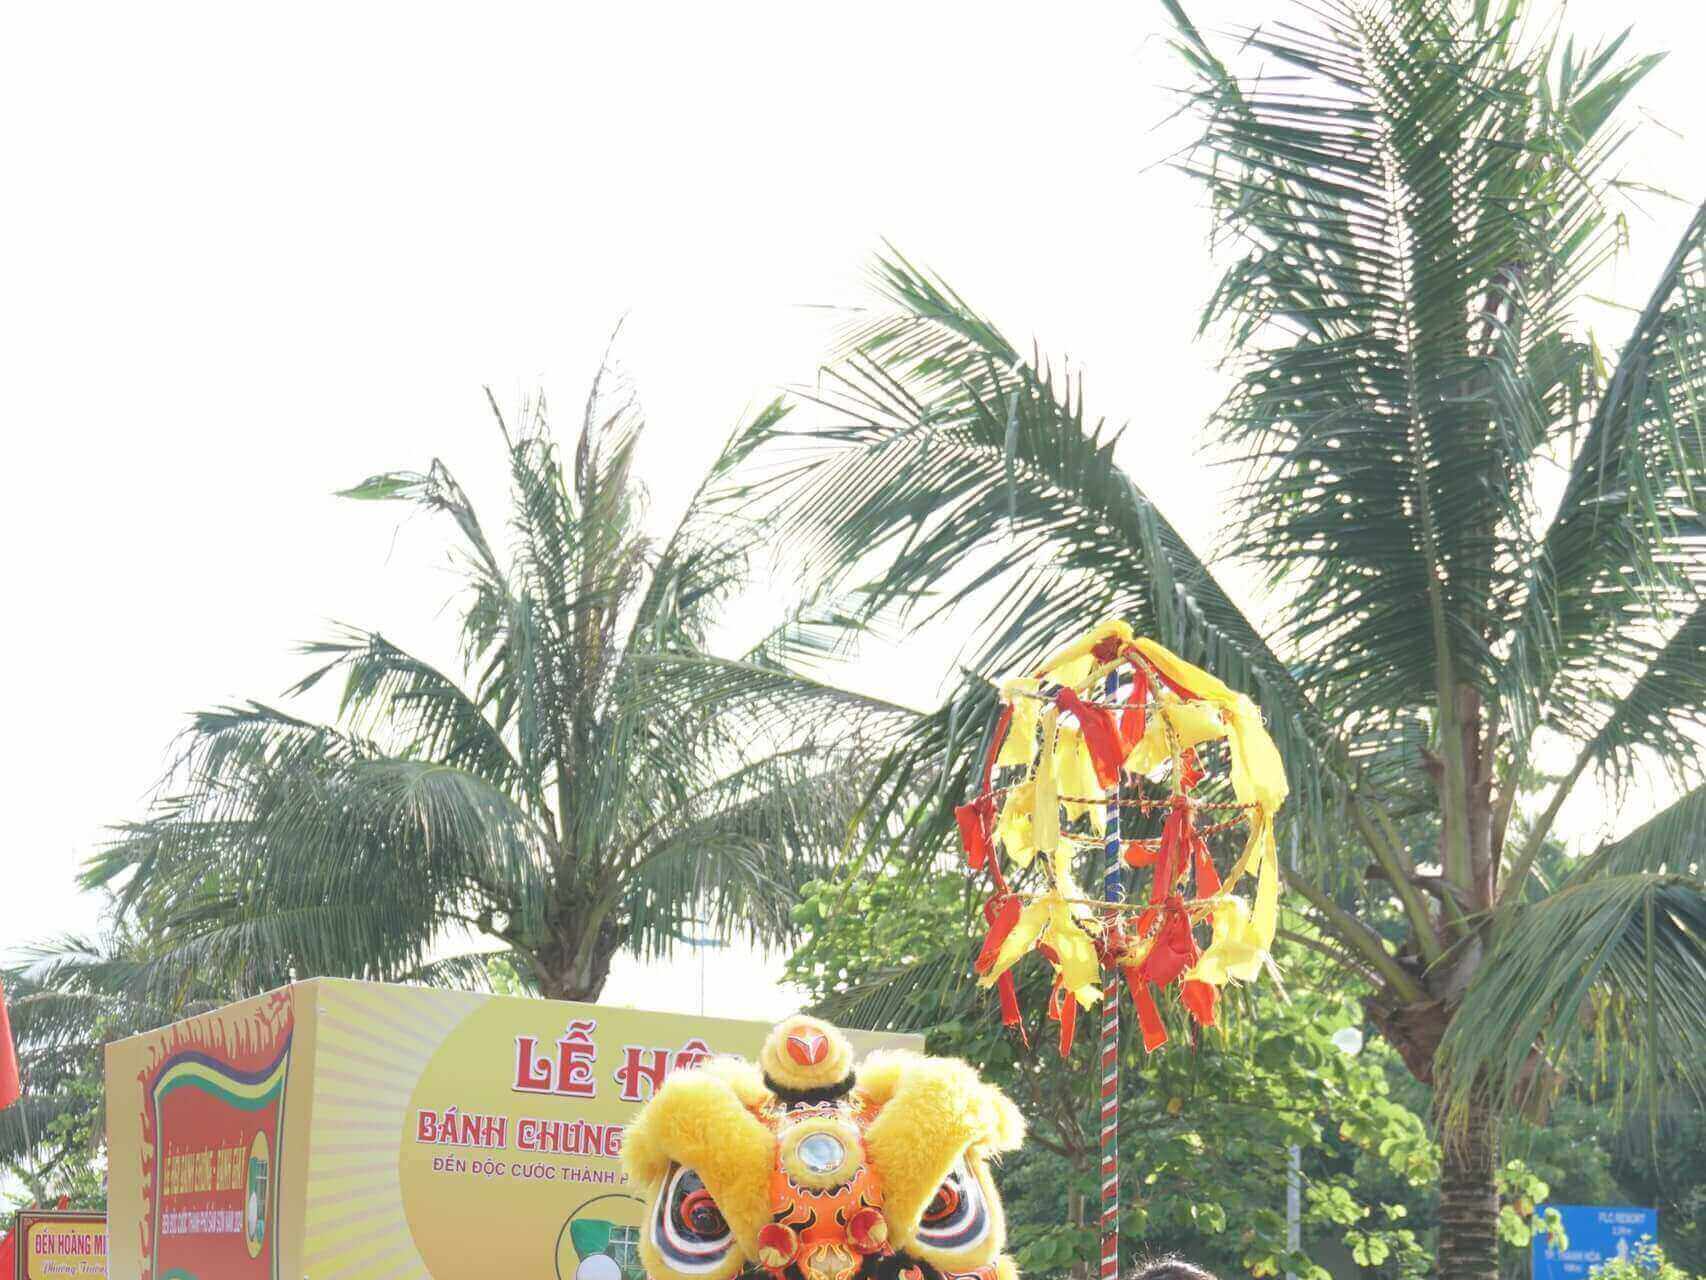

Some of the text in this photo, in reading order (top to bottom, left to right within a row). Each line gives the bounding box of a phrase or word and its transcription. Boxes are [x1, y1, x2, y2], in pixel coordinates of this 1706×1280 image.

[512, 1020, 596, 1097] LỄ
[416, 1105, 624, 1158] BÁNH CHƯNG
[472, 1158, 506, 1177] ĐỘC
[561, 1166, 615, 1184] THÀNH
[58, 1229, 91, 1255] HOÀNG
